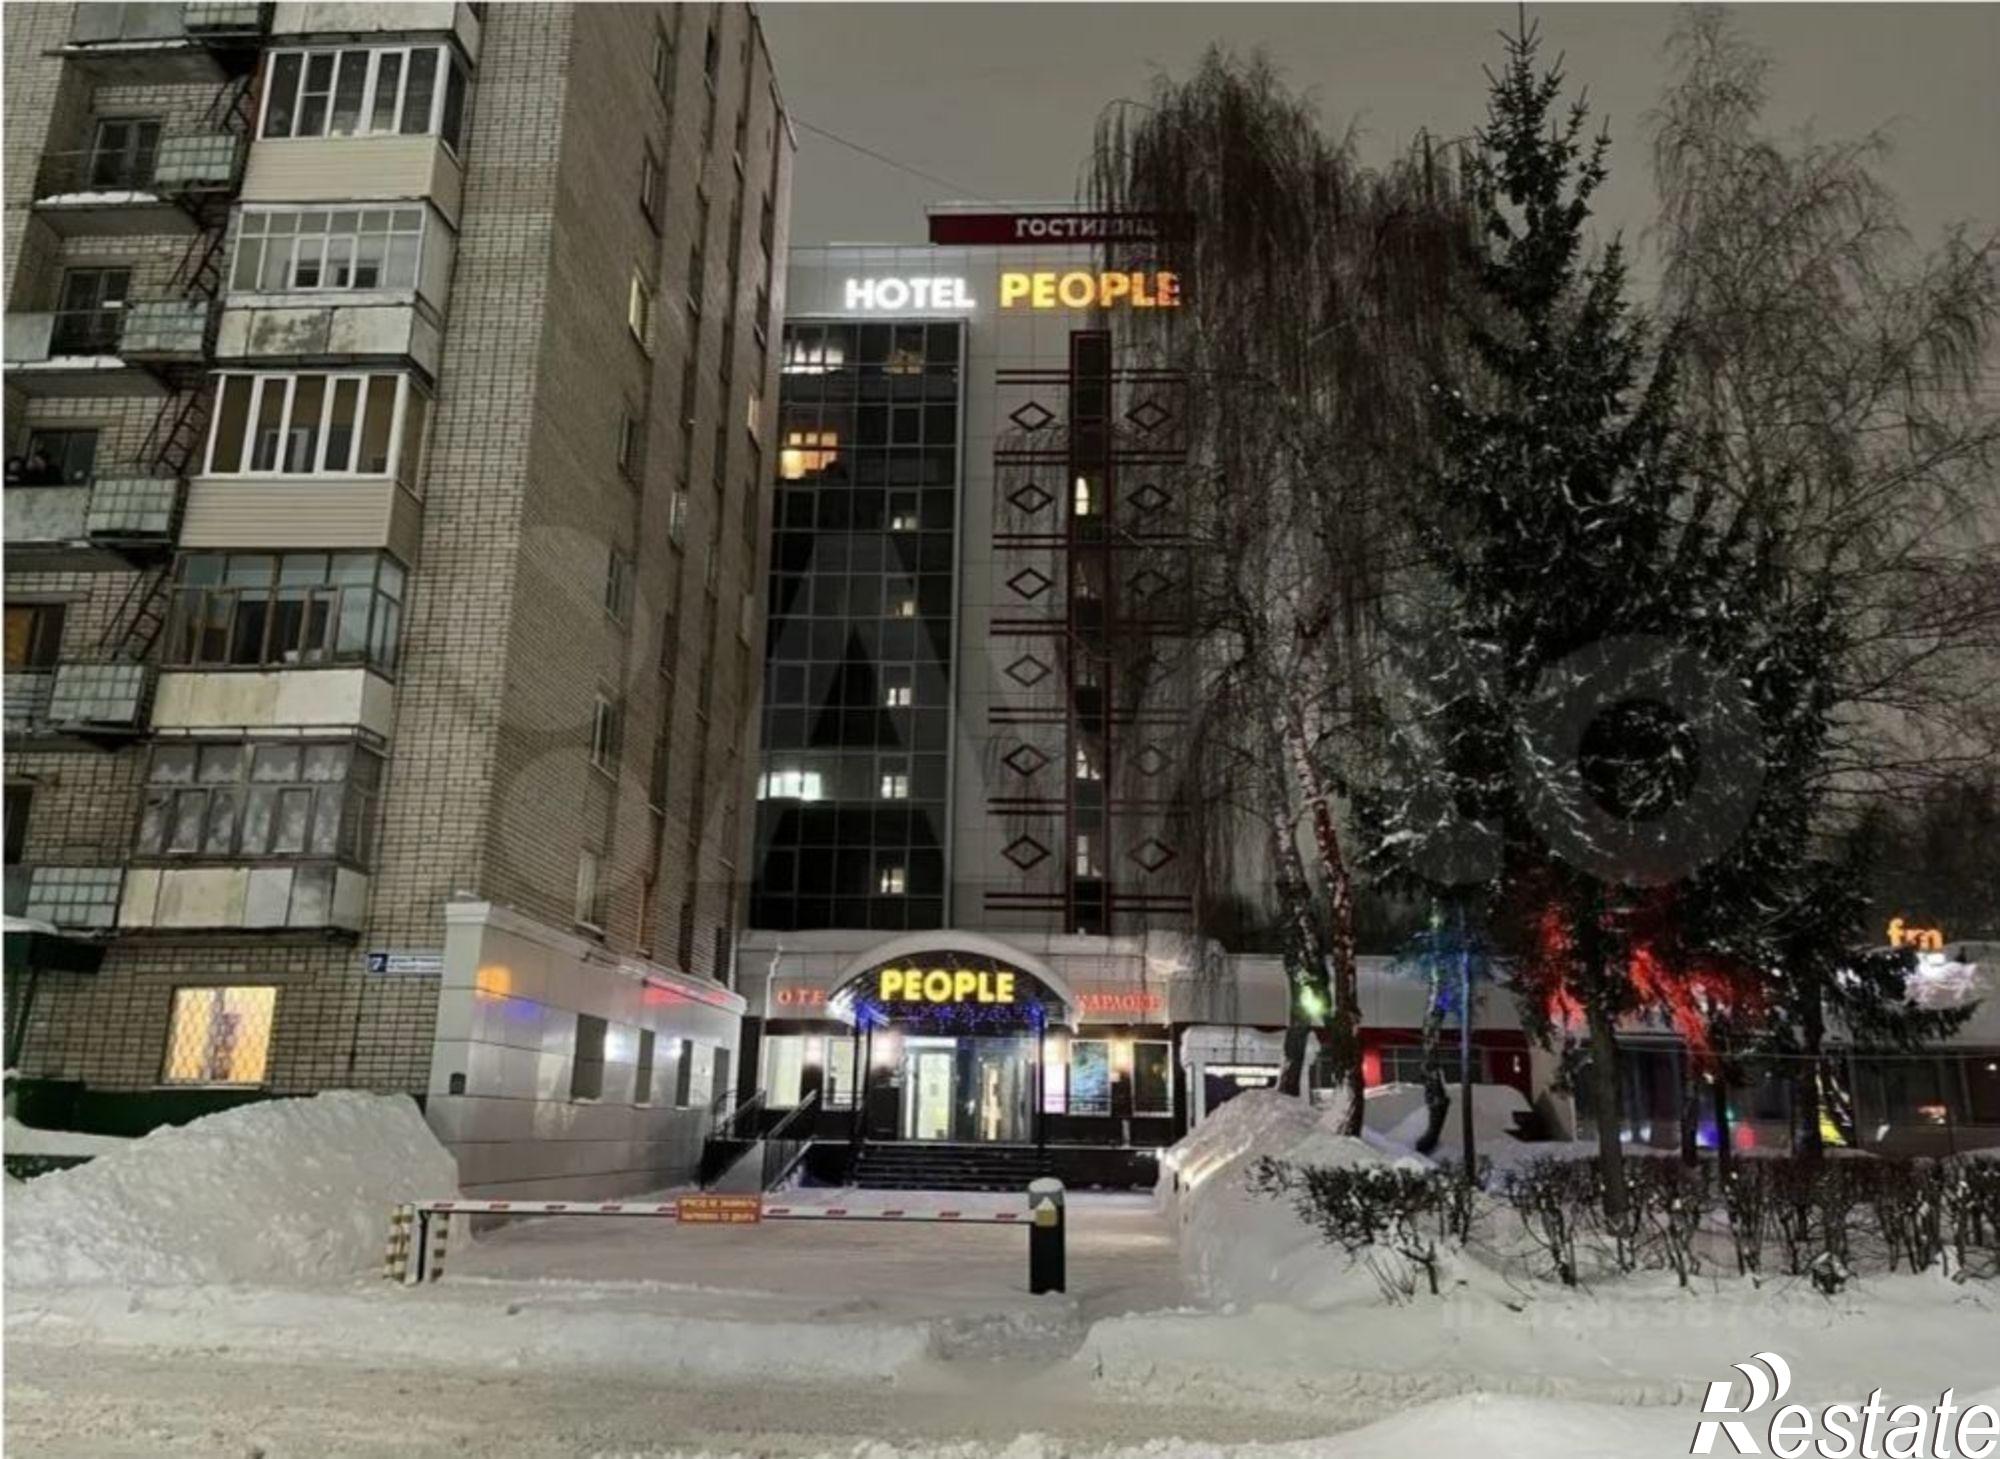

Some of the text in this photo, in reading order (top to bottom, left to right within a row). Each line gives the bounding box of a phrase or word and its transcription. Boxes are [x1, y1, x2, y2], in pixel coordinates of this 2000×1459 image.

[845, 271, 1181, 309] HOTEL PEOPLE
[879, 969, 1015, 1003] PEOPLE
